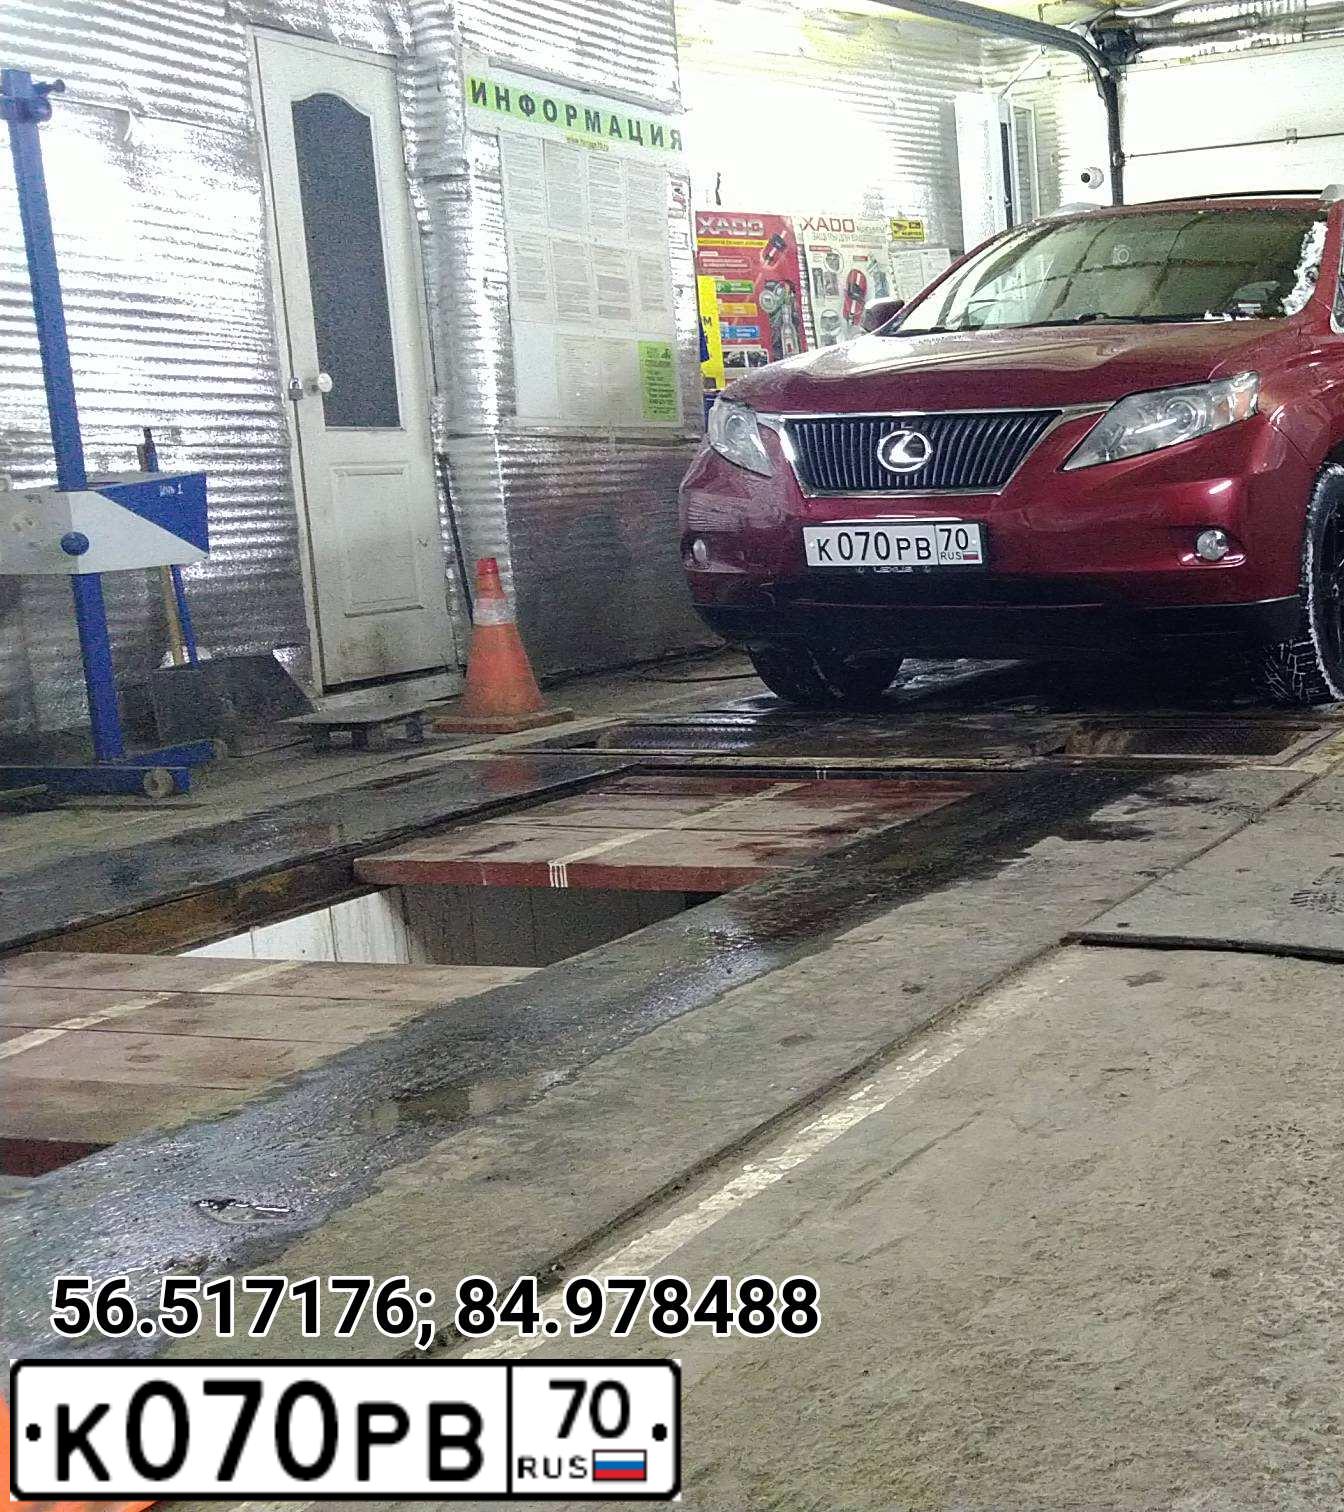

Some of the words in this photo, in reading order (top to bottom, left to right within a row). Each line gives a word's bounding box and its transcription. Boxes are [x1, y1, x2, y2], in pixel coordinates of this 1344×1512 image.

[470, 79, 683, 151] ИНФОРМАЦИЯ
[697, 216, 764, 236] XADO
[801, 216, 855, 233] XADO
[816, 531, 931, 561] К070РВ
[939, 528, 969, 551] 70
[941, 552, 962, 560] RUS
